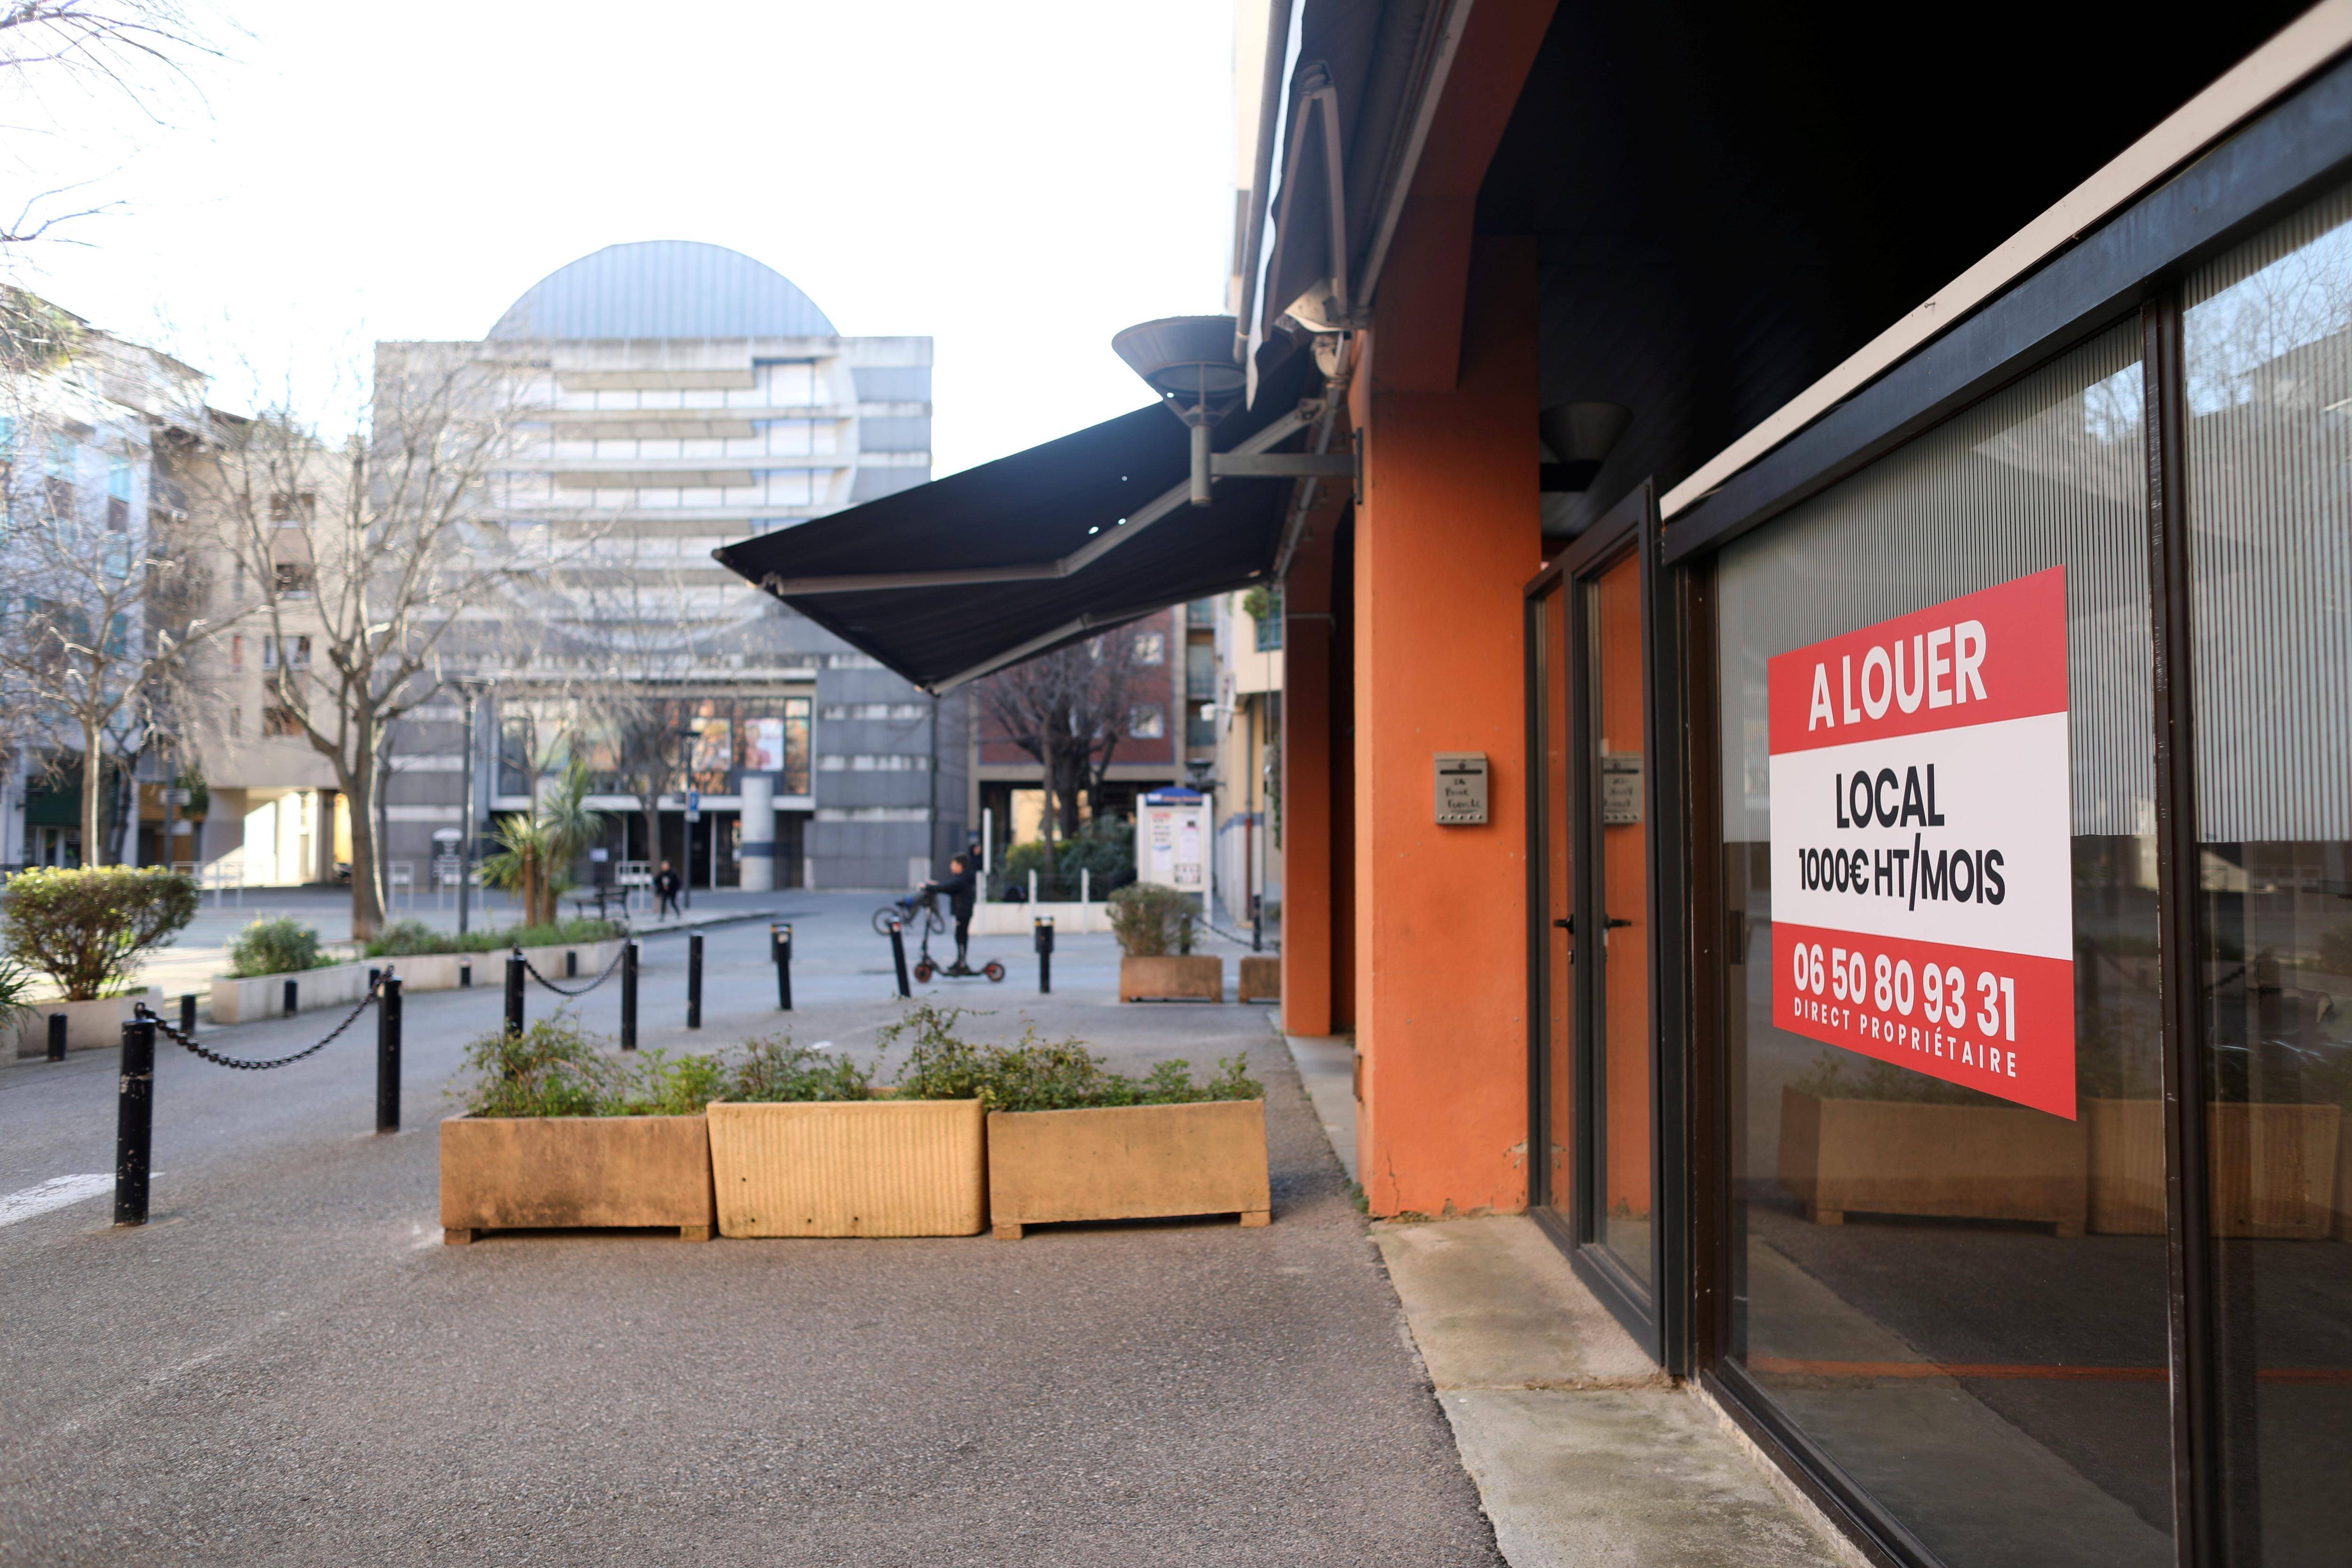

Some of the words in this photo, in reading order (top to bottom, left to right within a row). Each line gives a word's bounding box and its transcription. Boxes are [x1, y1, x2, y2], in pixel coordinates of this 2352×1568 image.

[1808, 662, 1835, 732] A
[1842, 620, 1988, 725] LOUER
[1836, 764, 1945, 829] LOCAL
[1798, 848, 1869, 895] 1000€
[1874, 832, 2006, 912] HT/MOIS
[1793, 942, 1825, 996] 06
[1832, 947, 1867, 1005] 50
[1874, 954, 1915, 1016] 80
[1922, 962, 1966, 1029] 93
[1976, 971, 2016, 1042] 31
[1794, 996, 1851, 1031] DIRECT
[1859, 1013, 2017, 1078] PROPRIÉTAIRE
